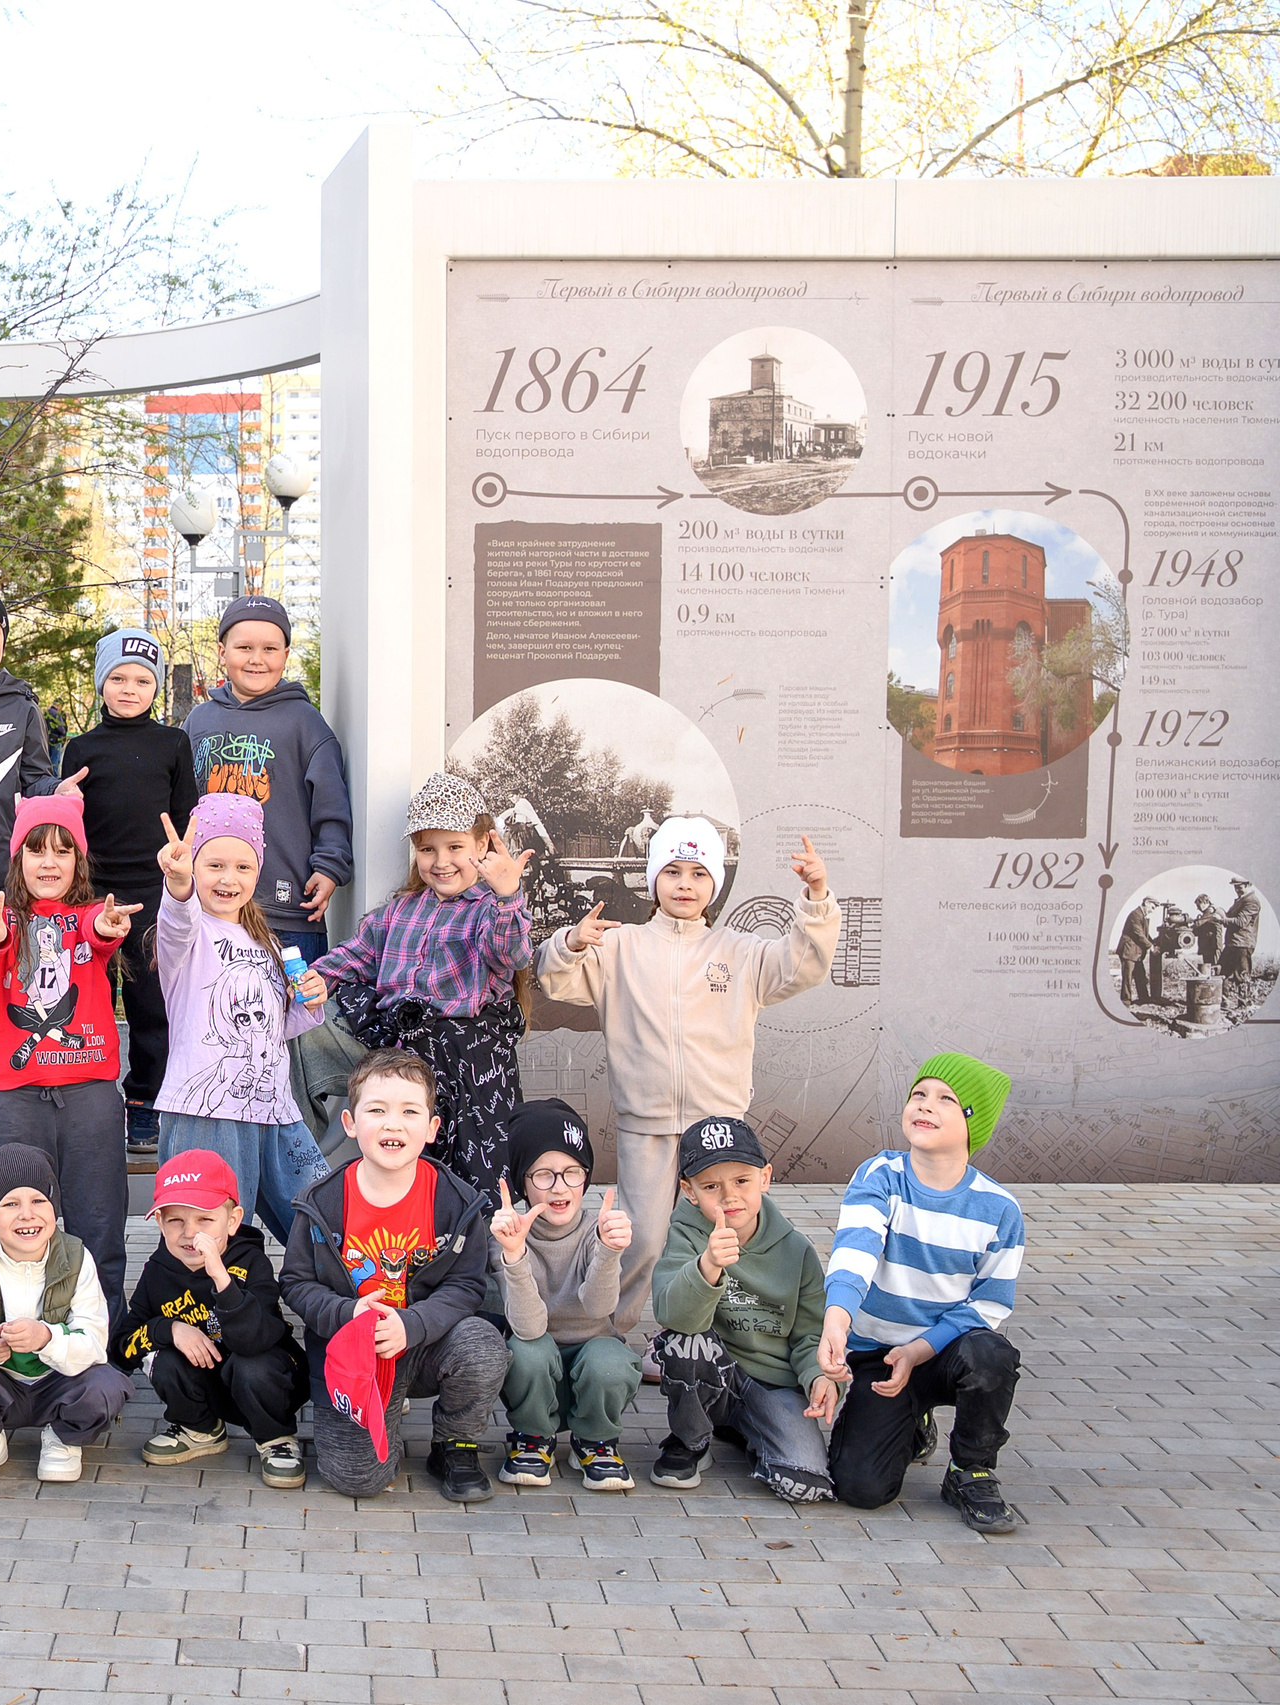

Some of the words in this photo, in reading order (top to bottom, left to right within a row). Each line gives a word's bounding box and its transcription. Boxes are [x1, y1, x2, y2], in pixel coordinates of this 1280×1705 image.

[536, 279, 613, 302] Первый
[618, 283, 626, 297] в
[631, 278, 702, 302] Сибири
[706, 280, 808, 302] водопровод
[971, 282, 1048, 306] Первый
[1052, 290, 1062, 302] в
[1066, 282, 1136, 306] Сибири
[1140, 284, 1245, 306] водопровод
[1115, 349, 1127, 368] 3
[1134, 349, 1174, 368] 000
[1180, 357, 1196, 368] м³
[1202, 358, 1240, 370] воды
[1246, 358, 1254, 368] в
[473, 346, 653, 414] 1864
[902, 349, 1071, 417] 1915
[1115, 391, 1140, 410] 32
[1147, 391, 1187, 410] 200
[1193, 401, 1254, 410] человек
[476, 429, 511, 443] Пуск
[515, 431, 576, 443] первого
[580, 431, 588, 440] в
[592, 428, 650, 443] Сибири
[908, 430, 944, 445] Пуск
[948, 430, 993, 442] новой
[1114, 432, 1135, 451] 21
[1144, 442, 1163, 452] км
[476, 448, 574, 460] водопровода
[908, 450, 986, 460] водокачки
[678, 520, 718, 539] 200
[724, 528, 740, 539] м³
[746, 530, 783, 541] воды
[790, 530, 797, 539] в
[802, 530, 844, 545] сутки
[487, 539, 515, 548] «Видя
[517, 540, 556, 548] крайнее
[529, 550, 572, 558] нагорной
[678, 546, 786, 554] производительность
[550, 560, 572, 569] Туры
[1143, 549, 1244, 587] 1948
[487, 569, 525, 578] берега»,
[576, 570, 623, 578] городской
[682, 562, 702, 581] 14
[710, 563, 744, 581] 100
[750, 572, 810, 582] человек
[545, 580, 589, 588] Подаруев
[804, 587, 845, 595] Тюмени
[1142, 595, 1197, 605] Головной
[1201, 595, 1264, 607] водозабор
[677, 604, 709, 626] 0,9
[716, 613, 734, 623] км
[1142, 609, 1155, 620] (р.
[1158, 609, 1188, 621] Тура)
[523, 620, 582, 628] сбережения.
[486, 632, 511, 640] Дело,
[677, 629, 756, 638] протяженность
[758, 630, 827, 638] водопровода
[1141, 627, 1155, 637] 27
[1157, 627, 1177, 637] 000
[1181, 627, 1191, 637] м³
[1202, 630, 1230, 640] сутки
[124, 640, 158, 660] UFC
[1142, 651, 1160, 661] 103
[1163, 652, 1183, 661] 000
[527, 652, 573, 661] Прокопий
[575, 652, 621, 661] Подаруев.
[1140, 675, 1160, 685] 149
[1132, 710, 1229, 747] 1972
[1136, 757, 1216, 767] Велижанский
[1135, 771, 1219, 782] (артезианские
[984, 852, 1084, 889] 1982
[939, 901, 1017, 910] Метелевский
[1020, 901, 1083, 912] водозабор
[1036, 914, 1049, 926] (р.
[1052, 914, 1082, 926] Тура)
[40, 968, 56, 989] 17
[81, 1024, 94, 1034] YOU
[86, 1035, 106, 1046] LOOK
[36, 1050, 106, 1065] WONDERFUL
[701, 1123, 732, 1138] OUT
[702, 1136, 735, 1150] SIDE
[163, 1173, 202, 1187] SANY
